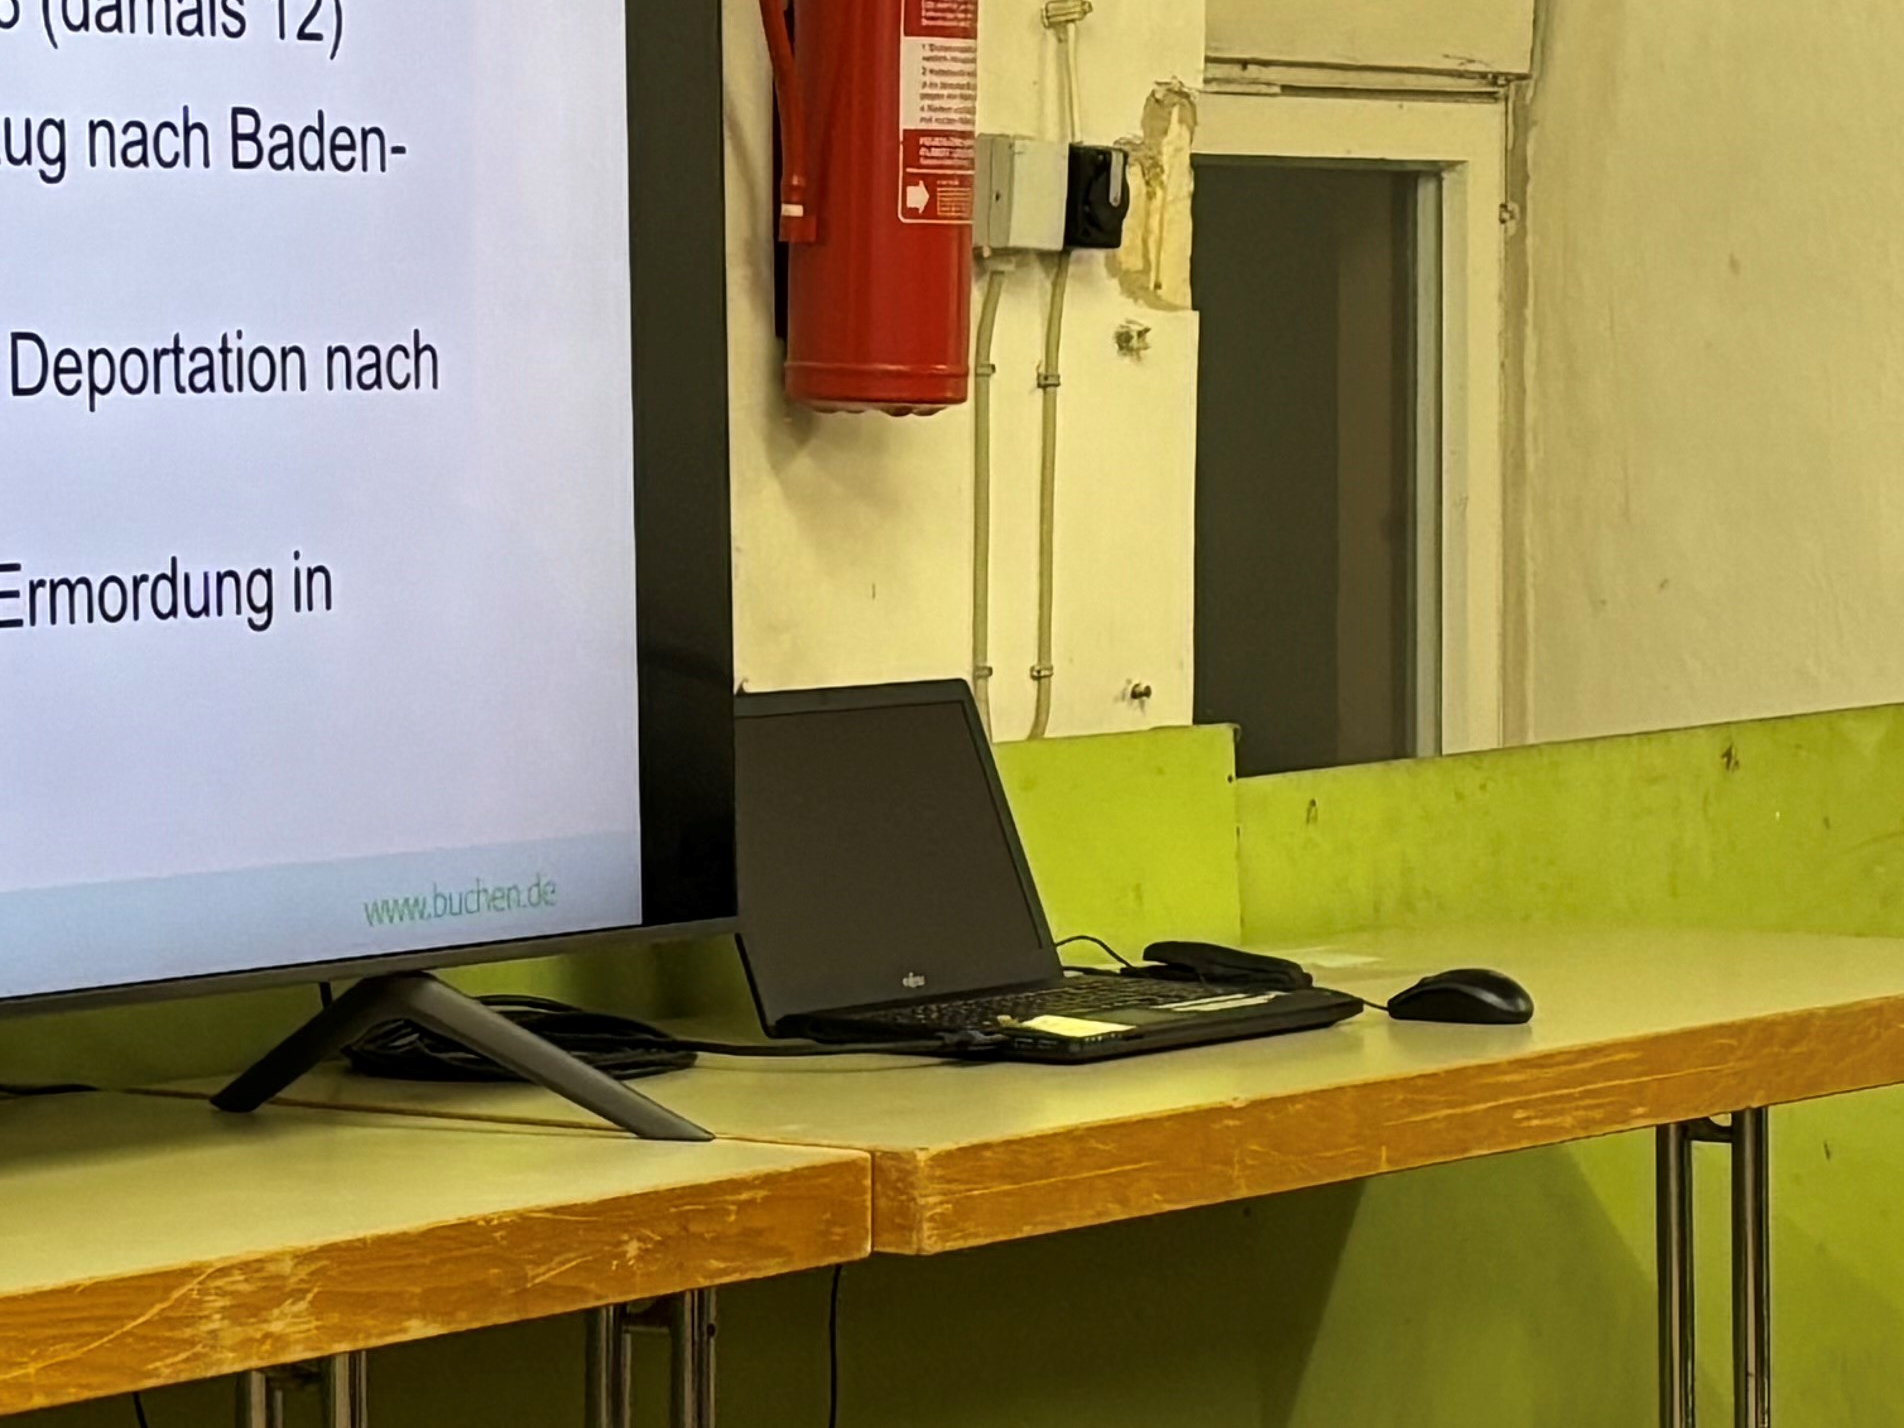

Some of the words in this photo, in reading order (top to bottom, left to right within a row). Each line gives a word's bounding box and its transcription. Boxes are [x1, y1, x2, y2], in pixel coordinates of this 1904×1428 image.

[89, 105, 210, 168] nach
[231, 107, 406, 172] Baden-
[11, 330, 306, 412] Deportation
[327, 329, 438, 391] nach
[294, 550, 331, 612] in
[363, 873, 557, 930] www.buchen.de
